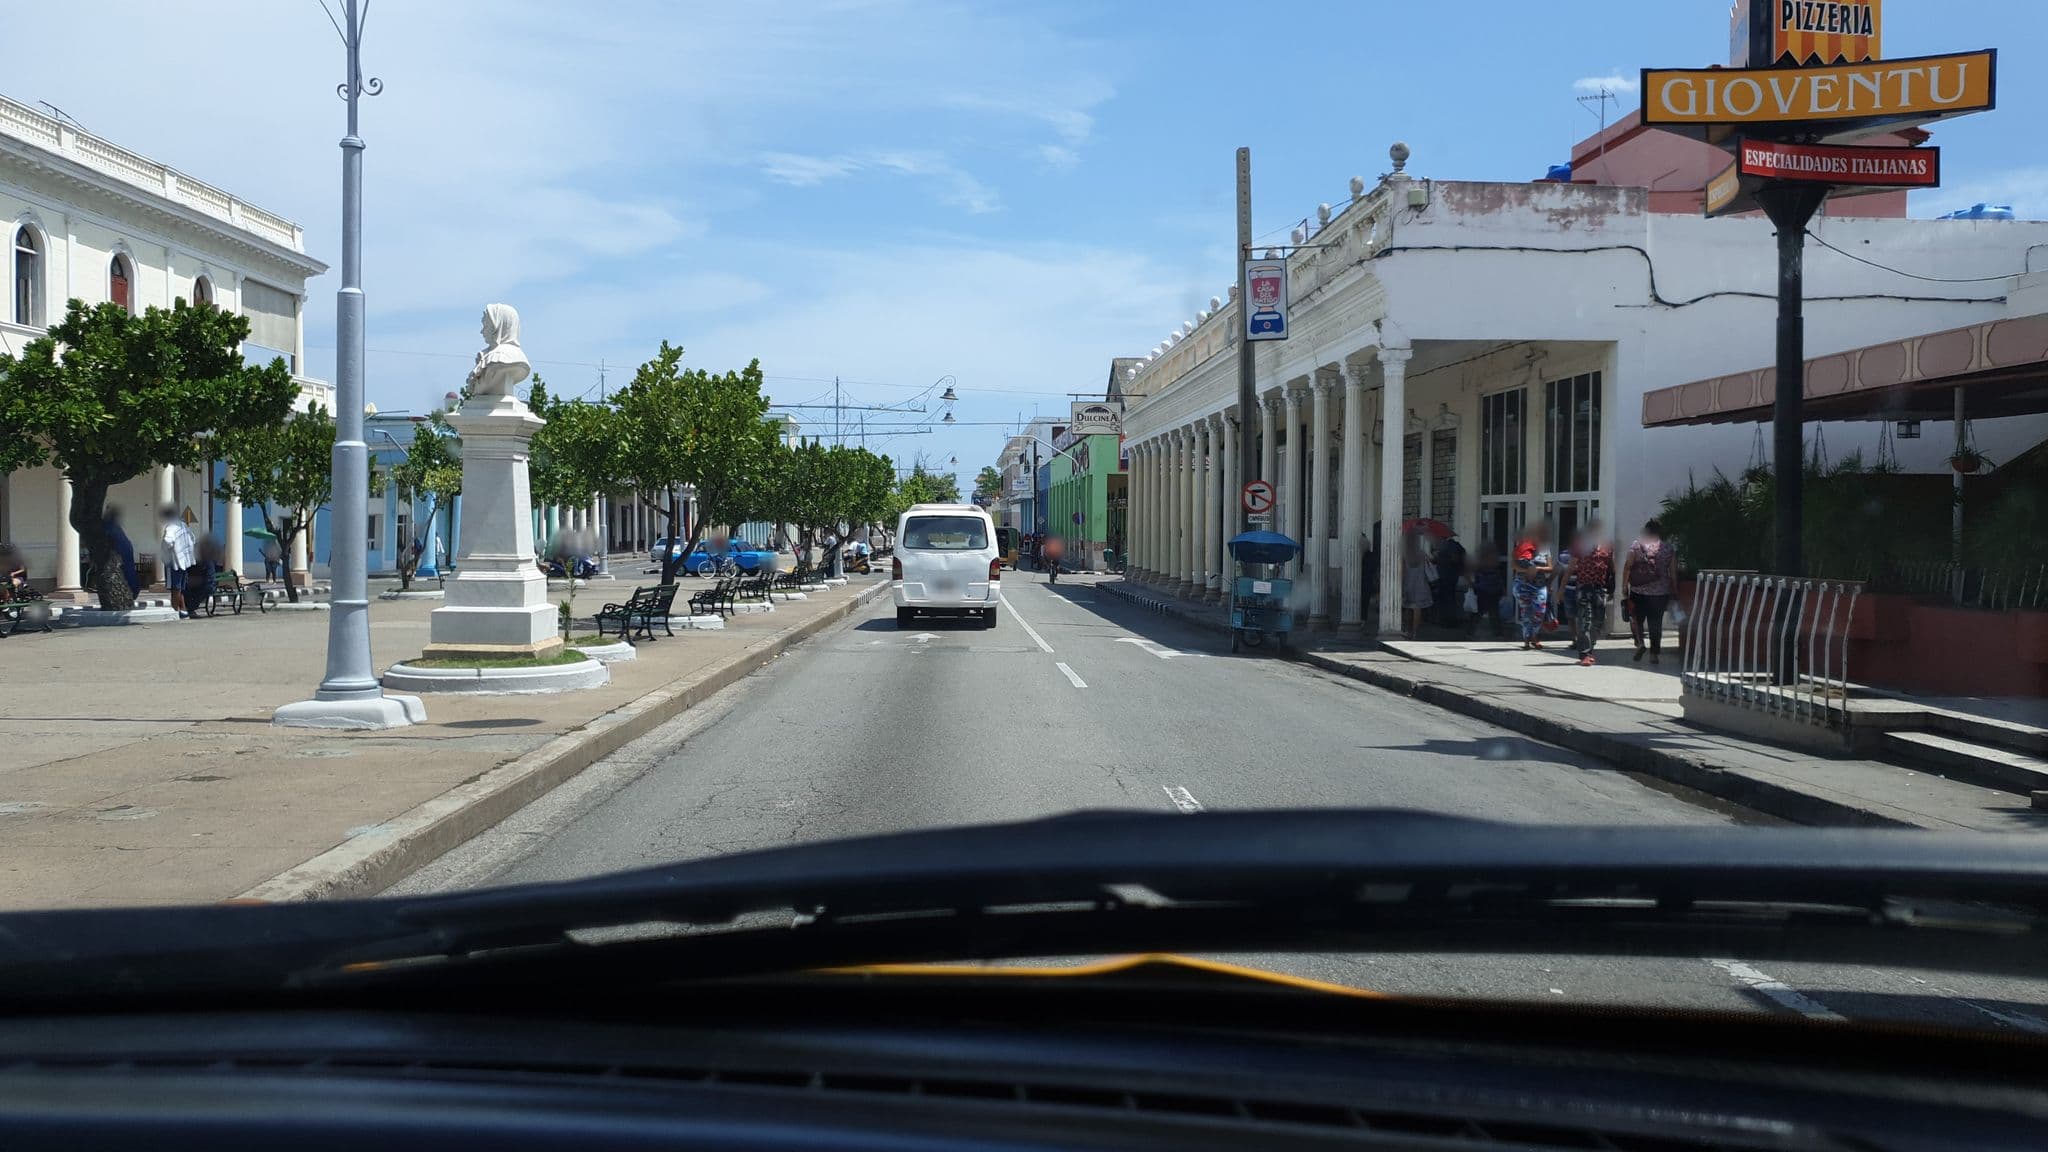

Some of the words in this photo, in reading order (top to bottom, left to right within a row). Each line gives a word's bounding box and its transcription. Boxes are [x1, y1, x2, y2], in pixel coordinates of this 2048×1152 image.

[1781, 0, 1874, 36] PIZZERIA
[1661, 63, 1968, 116] GIOVENTU
[1745, 149, 1848, 175] ESPECIALIDADES
[1851, 158, 1928, 176] ITALIANAS
[1077, 413, 1118, 422] DULCINEA
